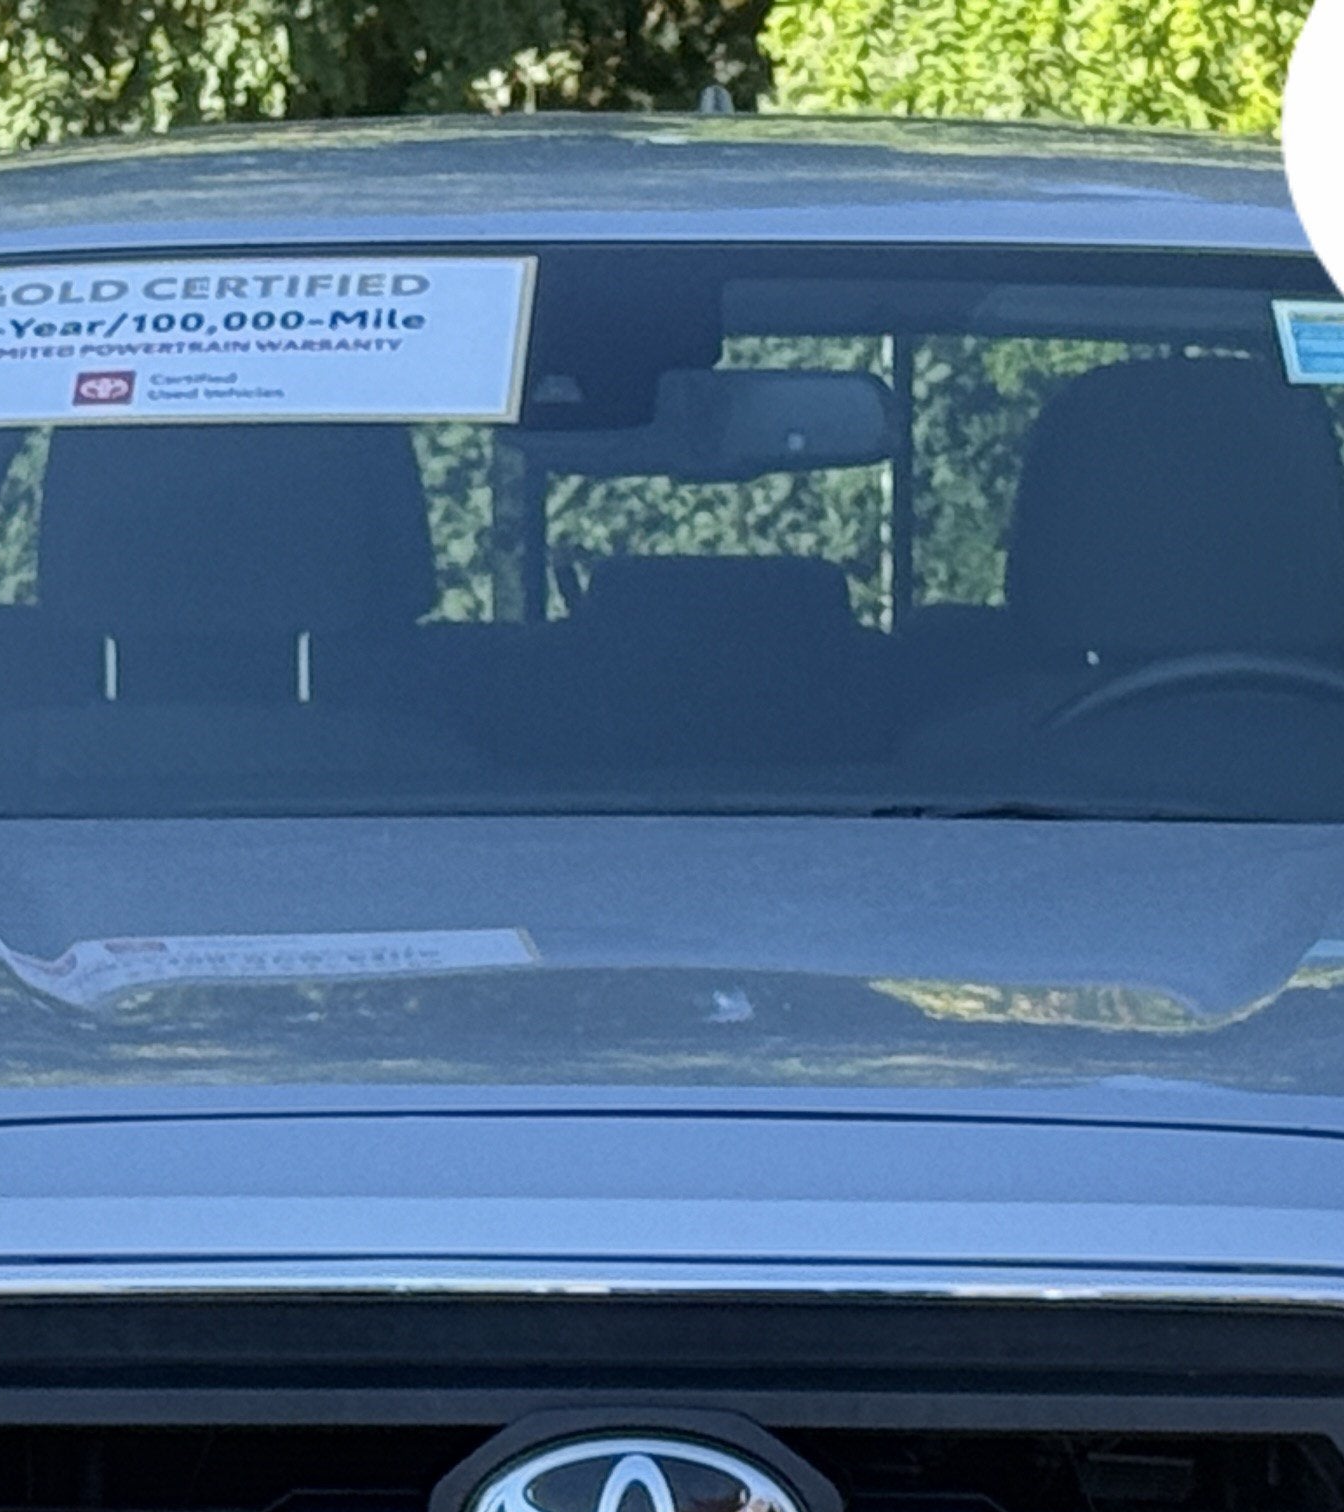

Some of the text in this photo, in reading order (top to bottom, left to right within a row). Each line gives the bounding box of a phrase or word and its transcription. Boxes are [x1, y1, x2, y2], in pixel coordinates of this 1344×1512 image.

[142, 272, 431, 301] CERTIFIED
[79, 339, 252, 358] POWERTRAIN
[254, 337, 404, 354] WARRANTY
